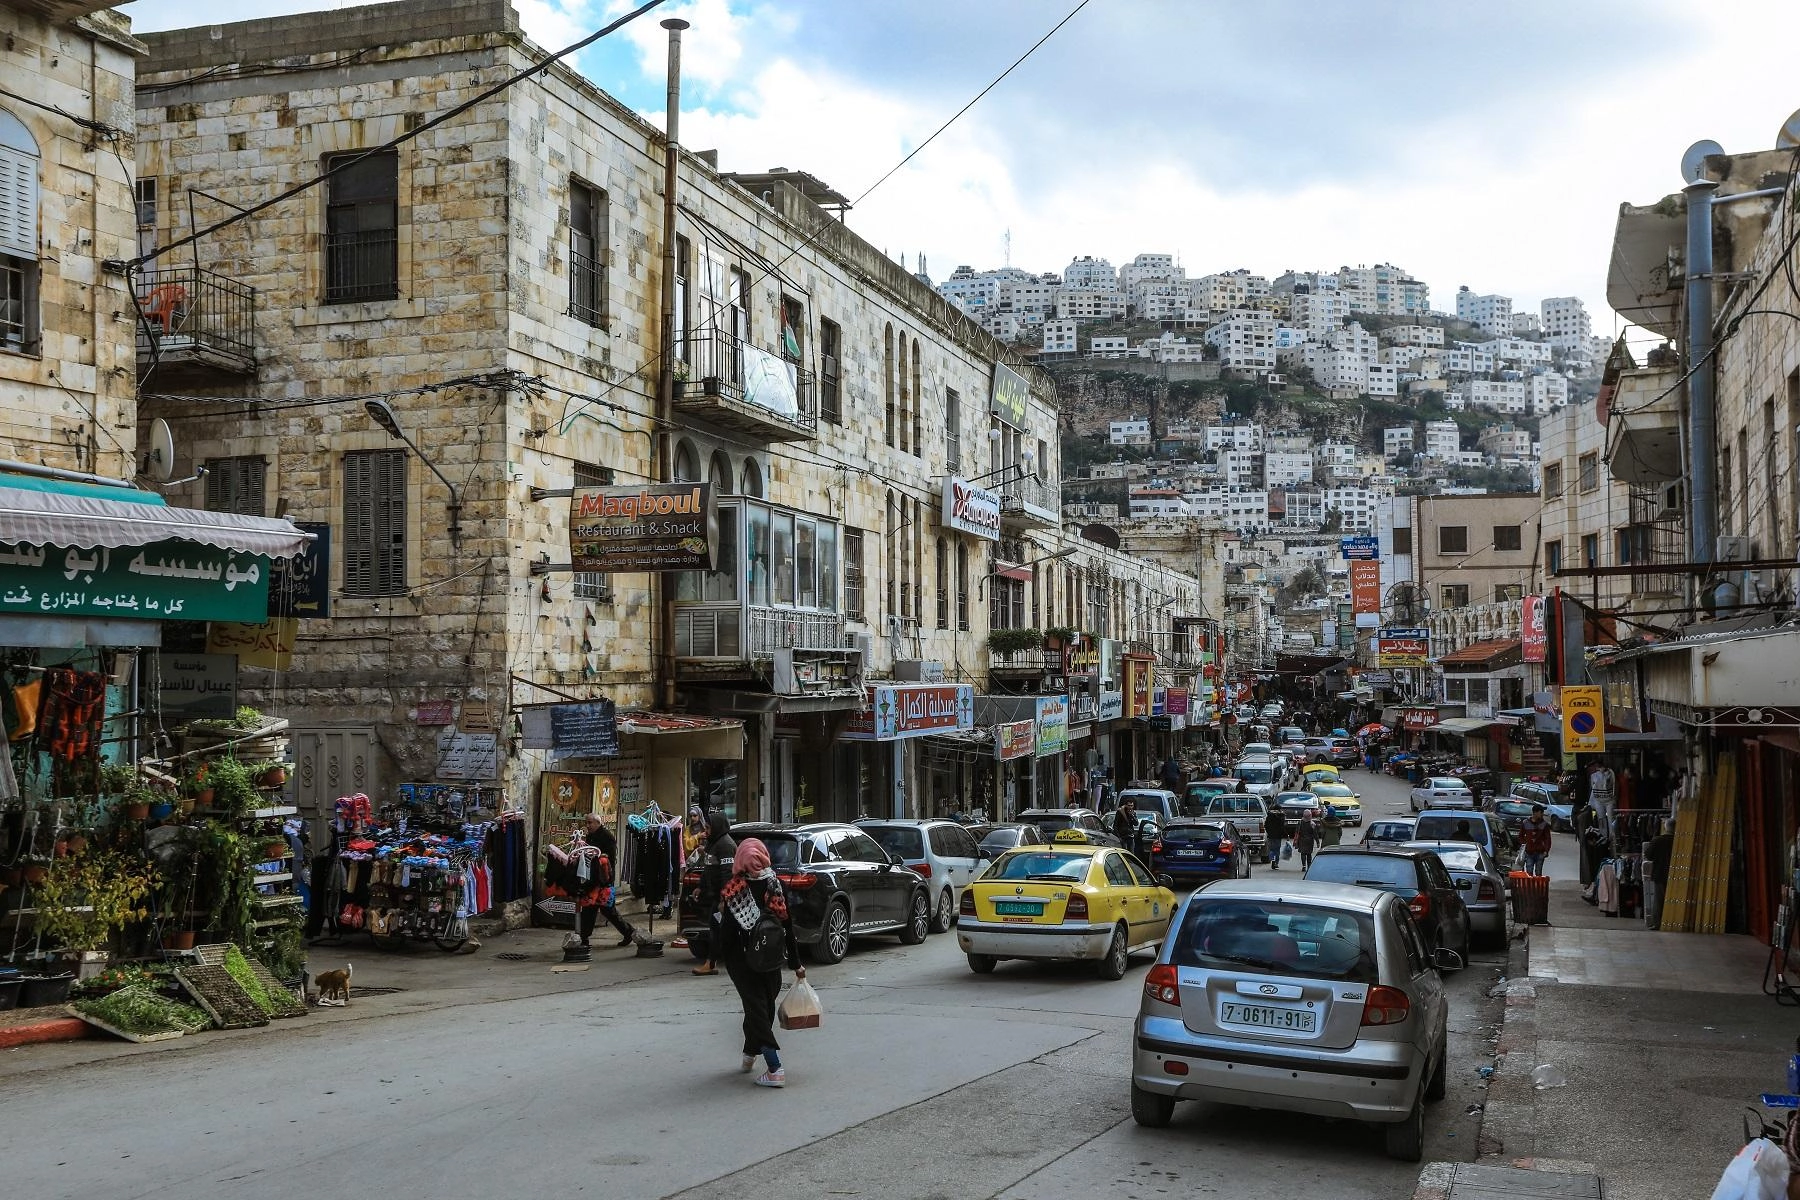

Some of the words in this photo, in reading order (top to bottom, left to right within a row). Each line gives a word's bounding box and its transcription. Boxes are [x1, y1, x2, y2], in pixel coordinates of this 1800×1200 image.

[578, 487, 701, 523] Maqboul
[577, 523, 646, 537] Restaurant
[649, 522, 660, 534] &
[663, 520, 700, 534] Snack
[40, 593, 85, 610] المزارع
[145, 597, 158, 610] ما
[164, 599, 184, 614] كل
[900, 692, 927, 729] الكمال
[929, 691, 955, 723] صيدلية
[558, 785, 573, 798] 24
